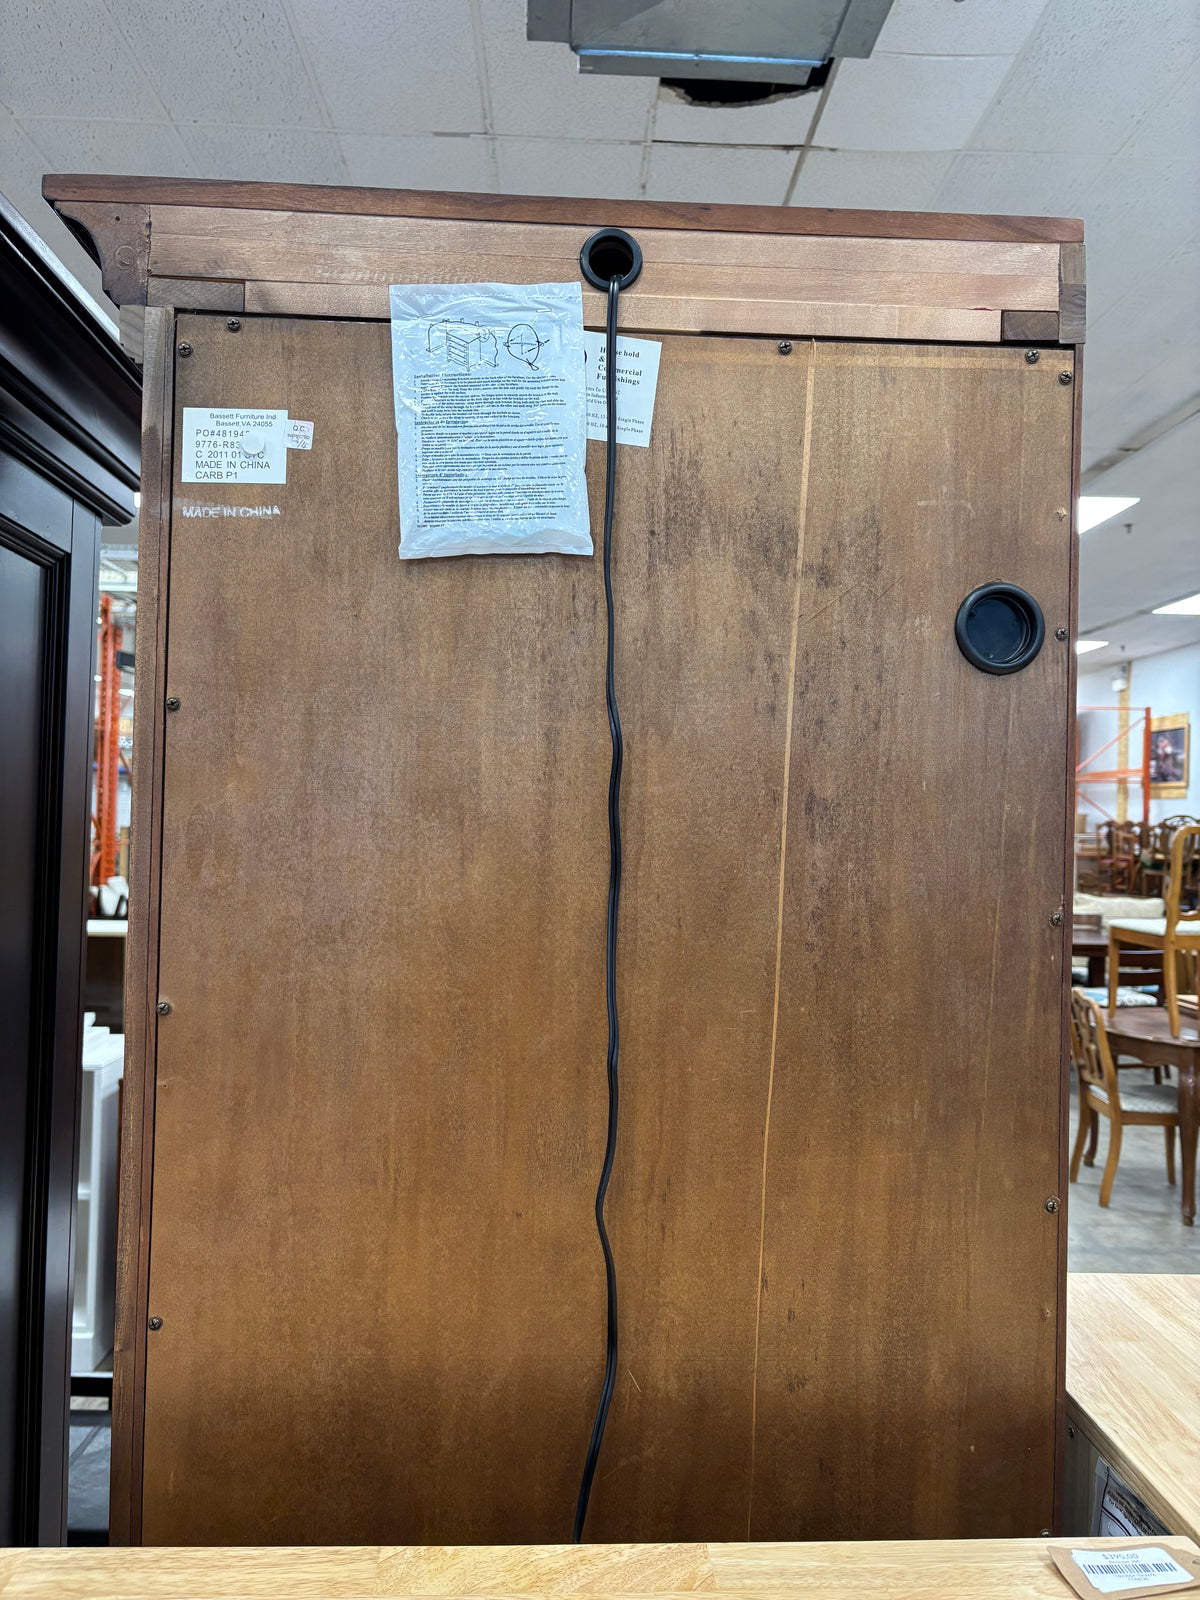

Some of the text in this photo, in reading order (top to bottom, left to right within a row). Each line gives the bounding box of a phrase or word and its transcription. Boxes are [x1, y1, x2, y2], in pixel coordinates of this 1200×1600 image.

[600, 346, 640, 358] Hse hold
[598, 355, 606, 363] &
[598, 364, 643, 377] Comercial
[596, 373, 640, 386] Fushings
[195, 429, 250, 438] PO#48194
[195, 451, 203, 459] C
[207, 451, 228, 459] 2011
[195, 461, 271, 469] MADE IN CHINA
[195, 471, 238, 480] CARB P1
[182, 505, 281, 518] MADE IN CHINA
